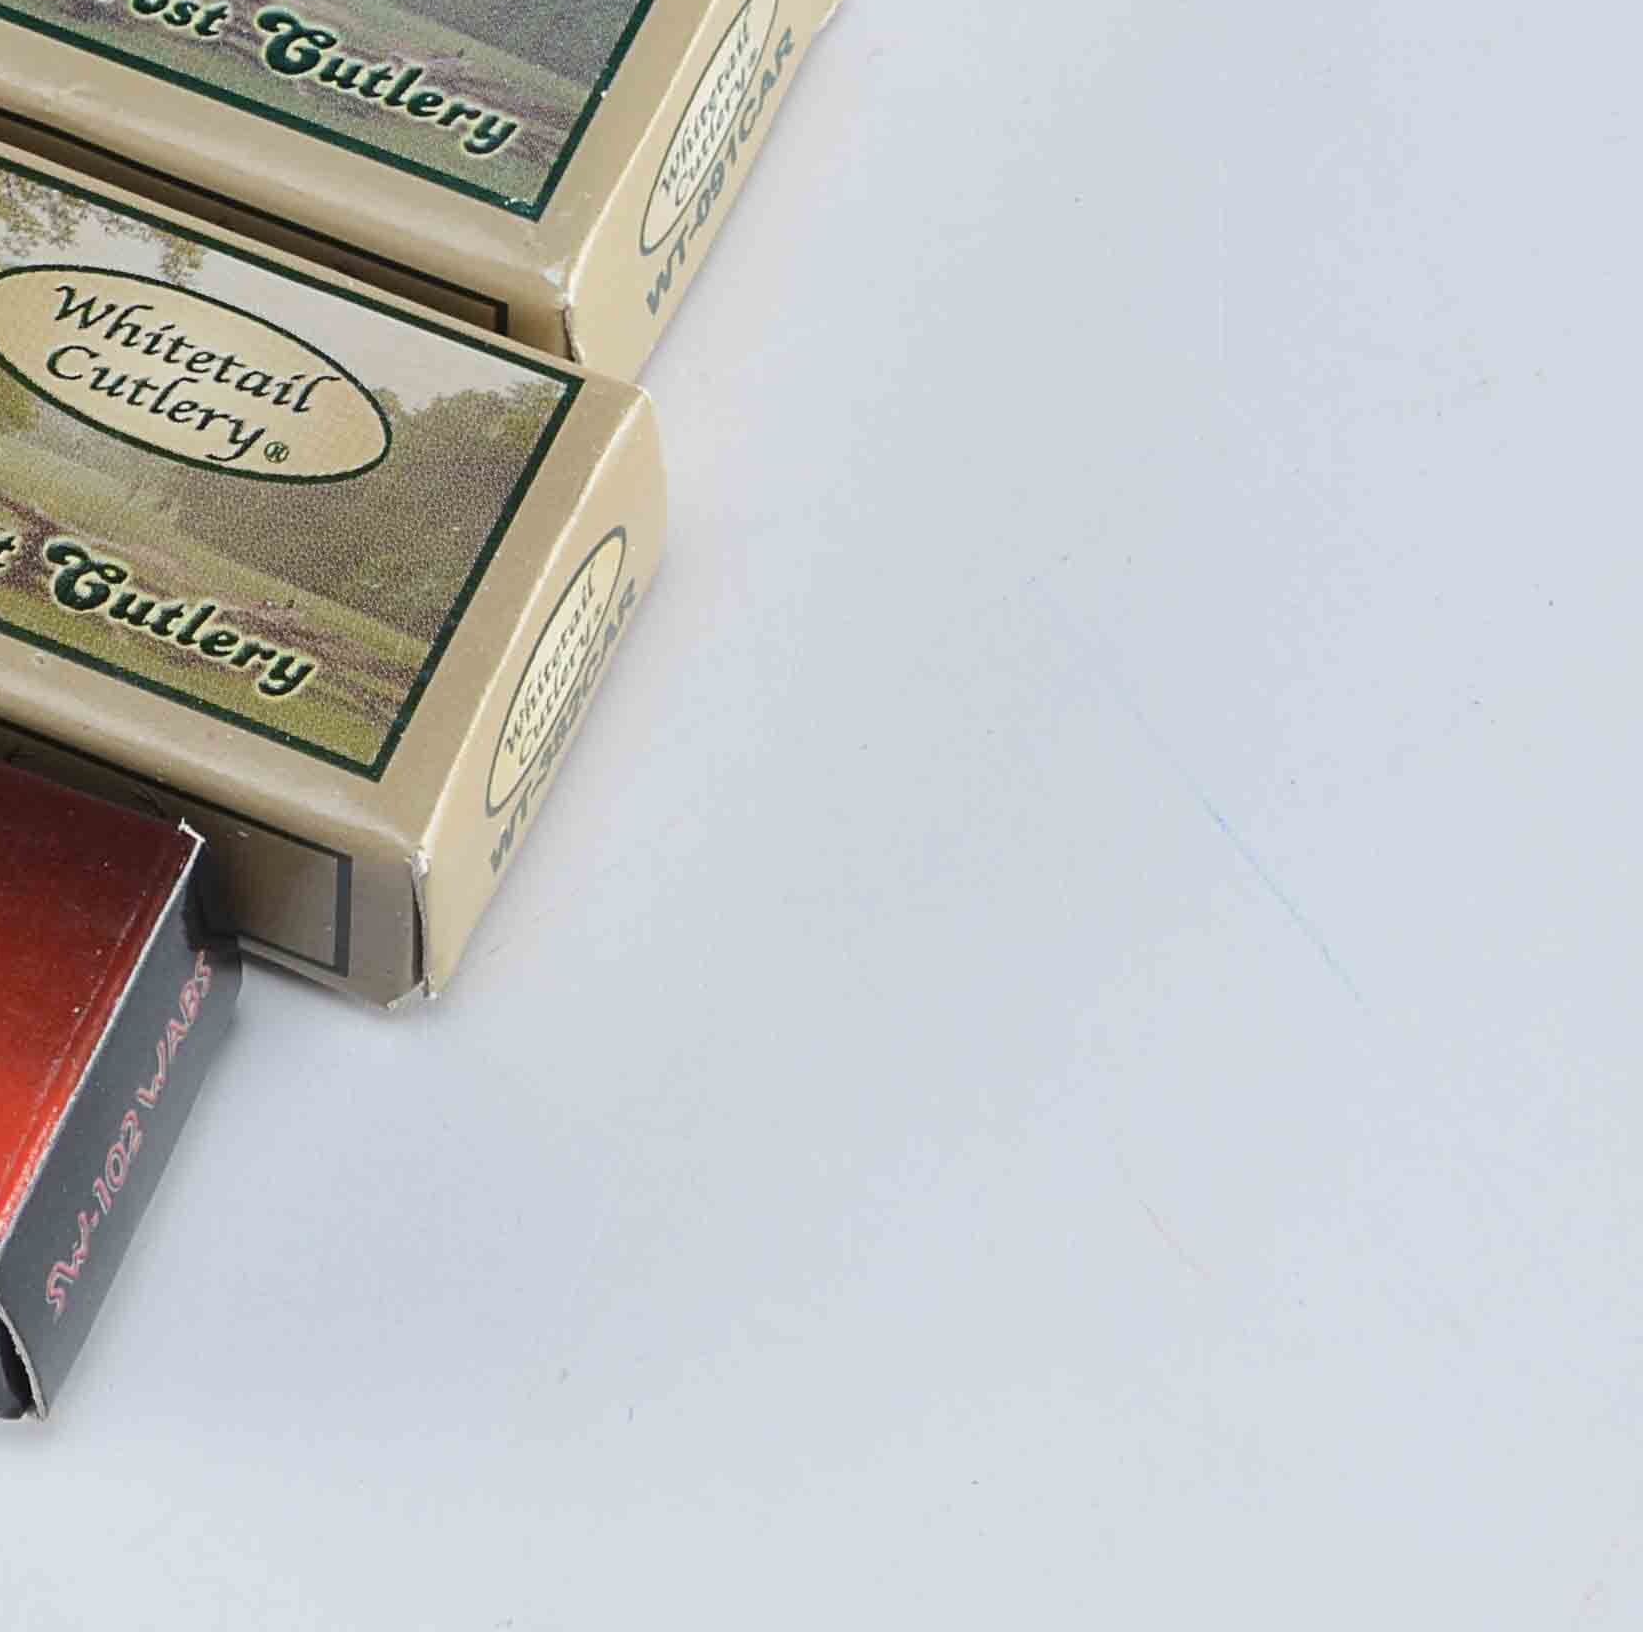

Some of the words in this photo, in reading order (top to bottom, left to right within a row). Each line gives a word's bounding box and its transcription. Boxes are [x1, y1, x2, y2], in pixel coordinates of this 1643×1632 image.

[257, 4, 519, 155] Cutlery
[660, 3, 750, 195] Whitetail
[53, 285, 342, 412] Whitetail
[45, 534, 317, 698] Cutlery
[506, 559, 595, 754] Whitetail
[46, 1109, 143, 1320] SW-102
[136, 948, 211, 1109] WABS
